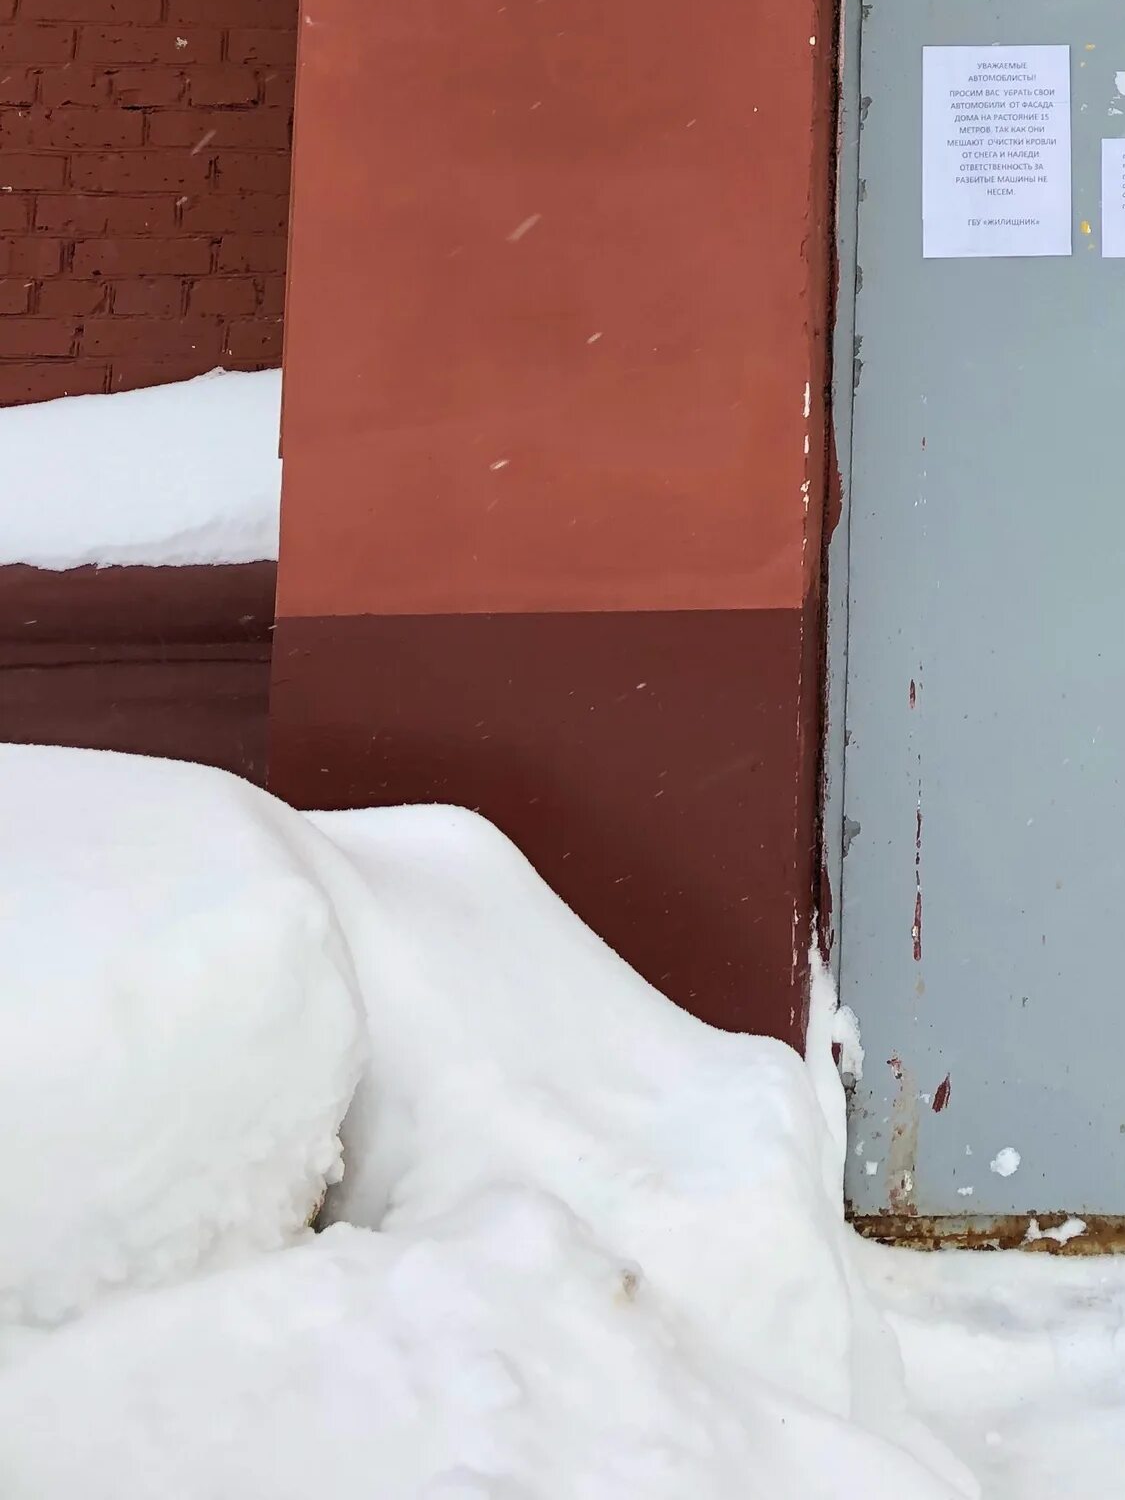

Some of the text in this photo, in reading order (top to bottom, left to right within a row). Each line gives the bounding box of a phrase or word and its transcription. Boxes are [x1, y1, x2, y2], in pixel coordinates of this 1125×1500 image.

[978, 62, 1027, 70] УВАЖАЕМЫЕ
[985, 89, 1000, 97] ВАС
[1022, 101, 1053, 109] ФАСАДА
[955, 114, 979, 122] ДОМА
[956, 176, 995, 184] РАЗБИТЫЕ
